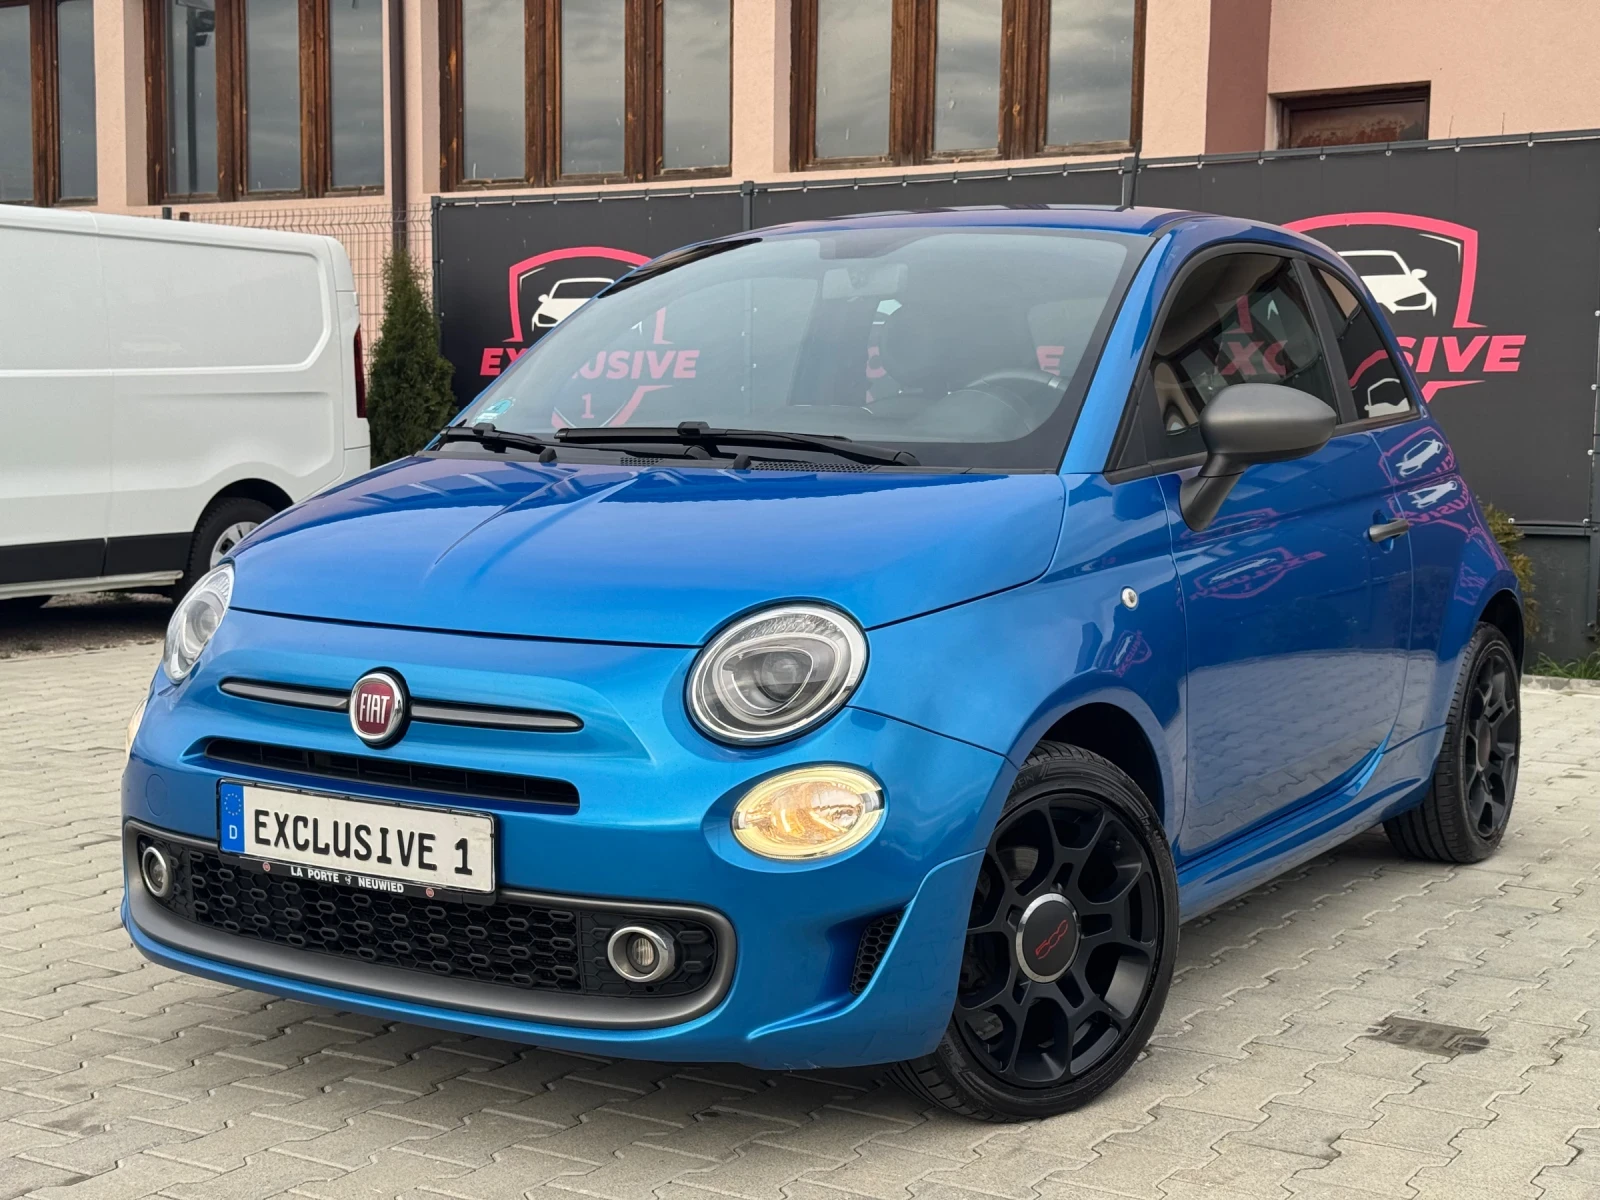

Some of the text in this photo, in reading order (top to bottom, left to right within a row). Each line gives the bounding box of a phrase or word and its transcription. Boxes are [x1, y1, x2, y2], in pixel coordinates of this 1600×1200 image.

[581, 393, 595, 419] 1
[360, 693, 390, 725] FIAT
[229, 809, 473, 876] D EXCLUSIVE 1
[290, 866, 405, 893] LA PORTE NEUWIED
